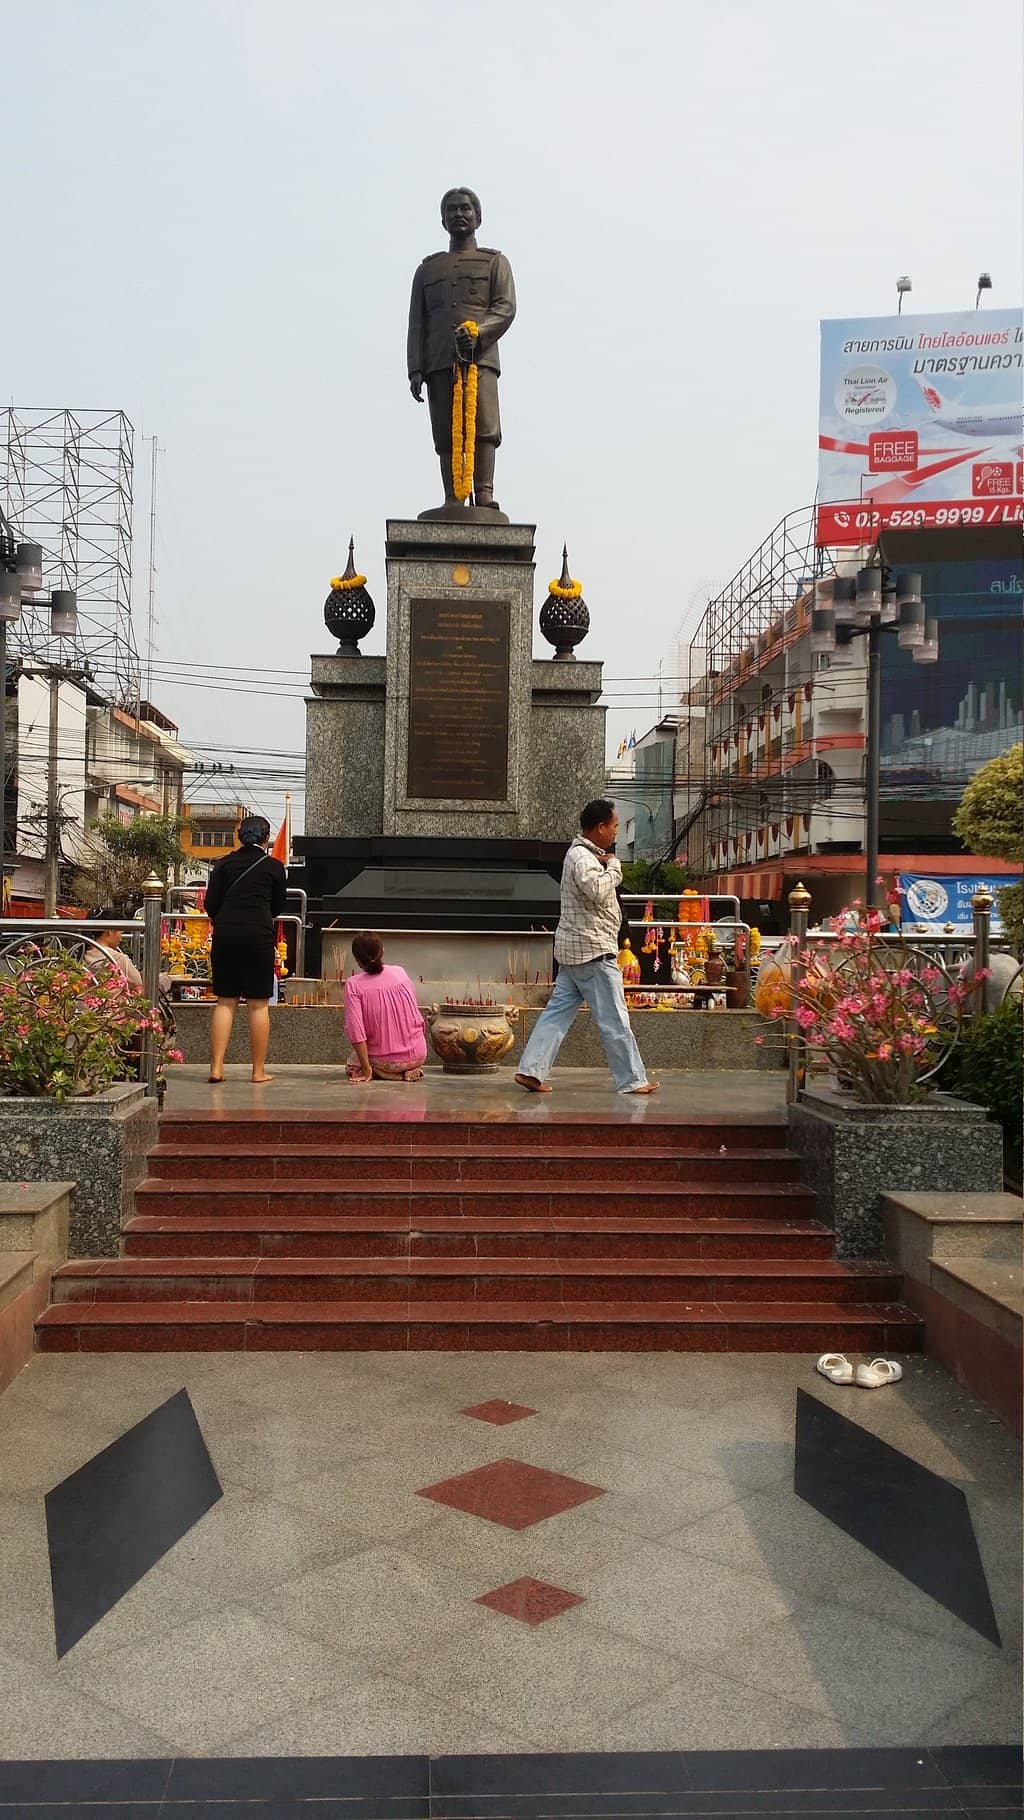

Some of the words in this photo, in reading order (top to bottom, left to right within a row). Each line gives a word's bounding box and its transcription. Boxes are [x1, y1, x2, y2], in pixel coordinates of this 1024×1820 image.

[843, 335, 914, 353] สายการบิน
[918, 328, 1011, 350] ไทยไลอ้อนแอร์
[913, 353, 1023, 376] มาตรฐานควา
[845, 406, 885, 415] Registered
[873, 440, 915, 456] FREE
[874, 455, 915, 464] BAGGAGE
[987, 477, 1011, 487] FREE
[855, 507, 984, 528] 02-529-9999
